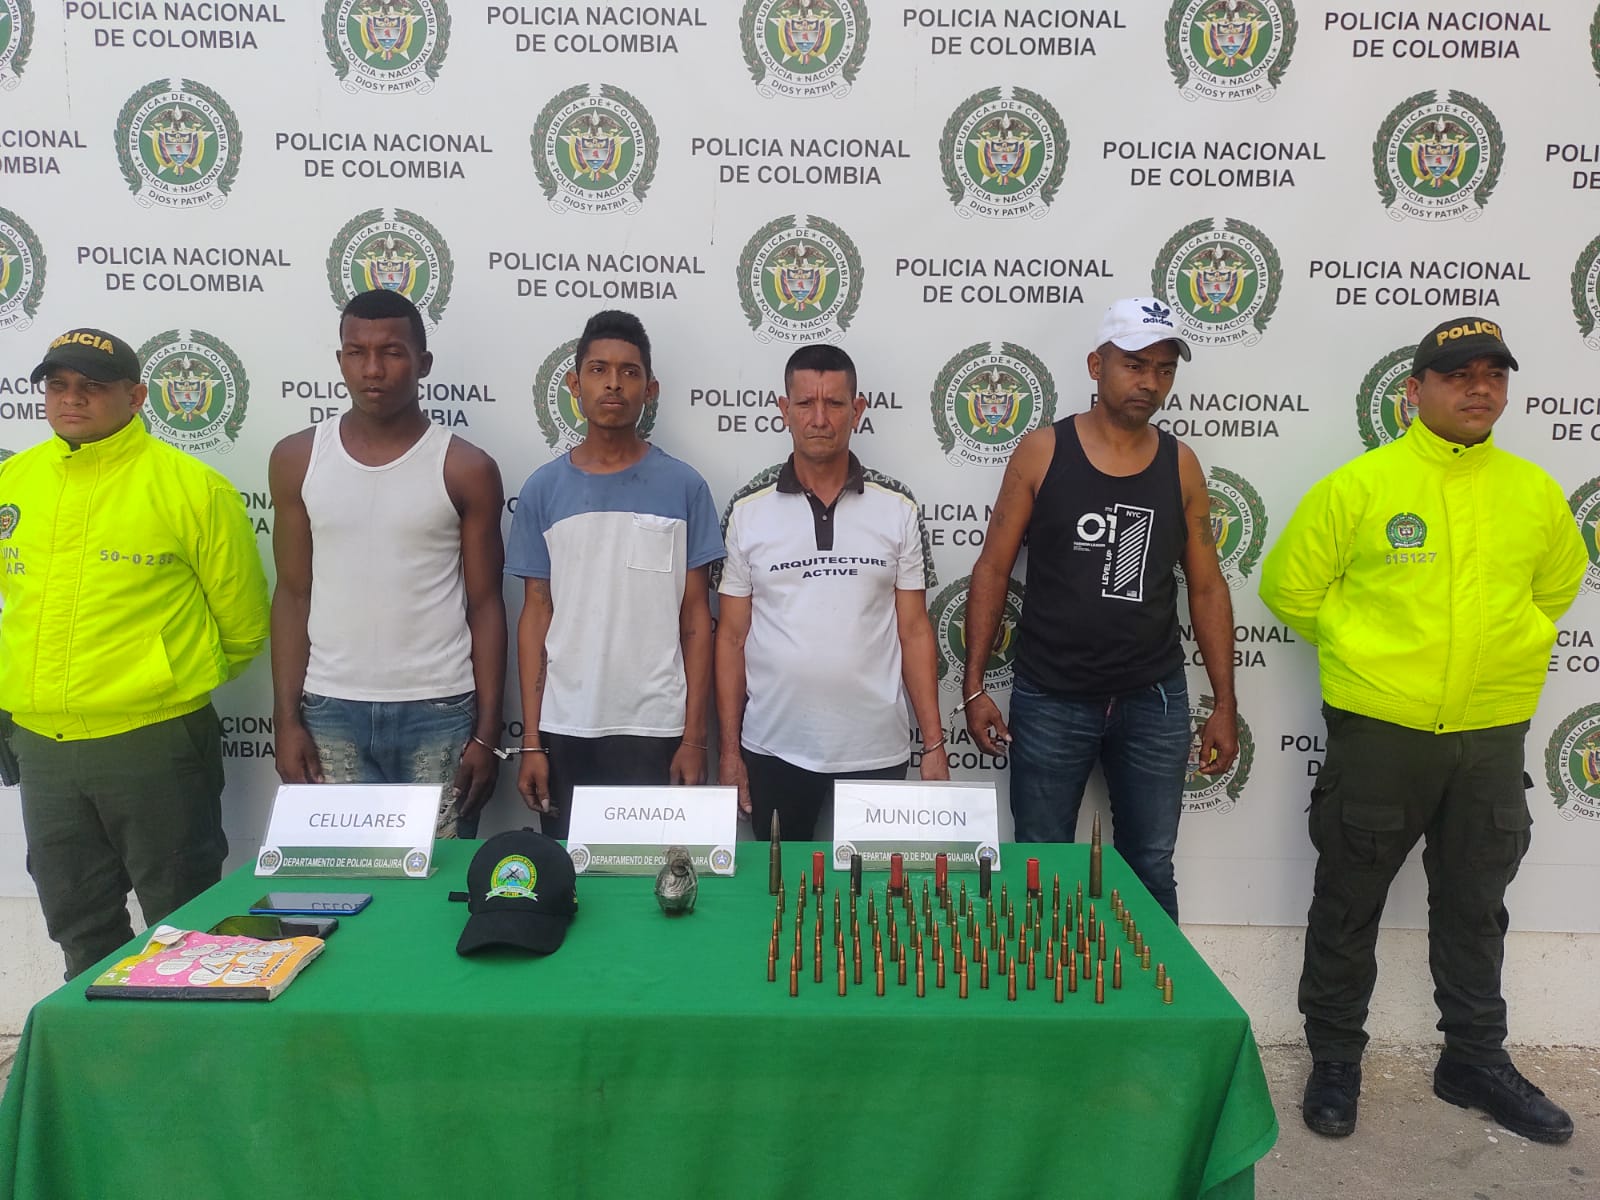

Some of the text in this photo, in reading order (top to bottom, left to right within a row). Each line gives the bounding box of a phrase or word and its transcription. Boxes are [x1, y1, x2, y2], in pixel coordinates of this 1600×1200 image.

[66, 2, 285, 23] POLICIA NACIONAL
[488, 7, 707, 27] POLICIA NACIONAL
[904, 9, 1126, 29] POLICIA NACIONAL
[1325, 12, 1551, 31] POLICIA NACIONAL
[95, 29, 257, 49] DE COLOMBIA
[517, 34, 678, 54] DE COLOMBIA
[932, 37, 1096, 56] DE COLOMBIA
[1353, 40, 1519, 59] DE COLOMBIA
[805, 53, 849, 82] NACIONAL
[1230, 56, 1275, 85] NACIONAL
[131, 99, 160, 150] REPUBLICA
[196, 100, 226, 150] COLOMBIA
[547, 104, 578, 155] REPUBLICA
[614, 105, 643, 156] COLOMBIA
[956, 107, 989, 159] REPUBLICA
[1025, 108, 1053, 160] COLOMBIA
[0, 130, 87, 148] CIONAL
[276, 133, 492, 153] POLICIA NACIONAL
[1389, 110, 1424, 162] REPUBLICA
[1461, 112, 1488, 162] COLOMBIA
[692, 138, 910, 158] POLICIA NACIONAL
[1104, 142, 1325, 160] POLICIA NACIONAL
[1546, 144, 1600, 162] POLI
[0, 156, 60, 174] MBIA
[305, 160, 464, 179] DE COLOMBIA
[181, 164, 223, 192] NACIONAL
[596, 170, 639, 198] NACIONAL
[720, 165, 881, 185] DE COLOMBIA
[1131, 169, 1295, 187] DE COLOMBIA
[1573, 171, 1600, 189] DE
[1004, 174, 1047, 203] NACIONAL
[1436, 177, 1482, 205] NACIONAL
[181, 192, 213, 205] PATRIA
[596, 198, 628, 211] PATRIA
[1003, 202, 1035, 216] PATRIA
[1435, 204, 1468, 218] PATRIA
[78, 247, 290, 267] POLICIA NACIONAL
[343, 228, 373, 278] REPUBLICA
[408, 230, 438, 279] COLOMBIA
[490, 252, 705, 274] POLICIA NACIONAL
[753, 235, 784, 286] REPUBLICA
[820, 237, 848, 287] COLOMBIA
[896, 259, 1113, 278] POLICIA NACIONAL
[1168, 238, 1202, 289] REPUBLICA
[1238, 239, 1266, 289] COLOMBIA
[1310, 261, 1530, 281] POLICIA NACIONAL
[106, 273, 264, 293] DE COLOMBIA
[518, 279, 677, 300] DE COLOMBIA
[924, 286, 1084, 304] DE COLOMBIA
[1336, 288, 1500, 307] DE COLOMBIA
[801, 301, 843, 328] NACIONAL
[1143, 318, 1173, 327] adidas
[1216, 303, 1260, 331] NACIONAL
[800, 328, 832, 341] PATRIA
[1215, 330, 1248, 343] PATRIA
[142, 348, 170, 384] PUBLICA
[204, 350, 234, 398] COLOMBIA
[550, 358, 574, 404] REPUBLIC
[282, 381, 496, 402] POLIC IONAL
[947, 361, 979, 410] REPUBLICA
[1014, 363, 1041, 411] COLOMBIA
[1372, 364, 1407, 413] REPUBLICA
[691, 389, 779, 408] POLICIA
[1190, 394, 1309, 412] NACIONAL
[1526, 397, 1600, 415] POLICI
[190, 412, 230, 438] NACIONAL
[310, 407, 339, 424] DE
[718, 415, 747, 432] DE
[1157, 419, 1279, 437] COLOMBIA
[1552, 424, 1583, 441] DE
[921, 504, 978, 521] LICIA
[1126, 510, 1142, 518] NYC
[1223, 487, 1250, 534] COLOMBIA
[769, 557, 887, 572] ARQUITECTURE
[802, 568, 858, 579] ACTIVE
[1102, 549, 1113, 585] LEVEL UP
[1179, 625, 1295, 643] NONAL
[219, 717, 273, 734] CION
[223, 741, 276, 758] MBIA
[1561, 720, 1595, 766] REPUBLICA
[947, 752, 1008, 770] COLO
[1190, 798, 1221, 810] PATRIA
[309, 813, 406, 828] CELULARES
[604, 807, 686, 821] GRANADA
[866, 808, 966, 826] MUNICION
[283, 858, 402, 868] DEPARTAMENTO DE POLICIA GUAJIRA
[591, 855, 642, 865] DEPARTAMENTO
[644, 856, 653, 865] DE
[911, 852, 919, 861] DE
